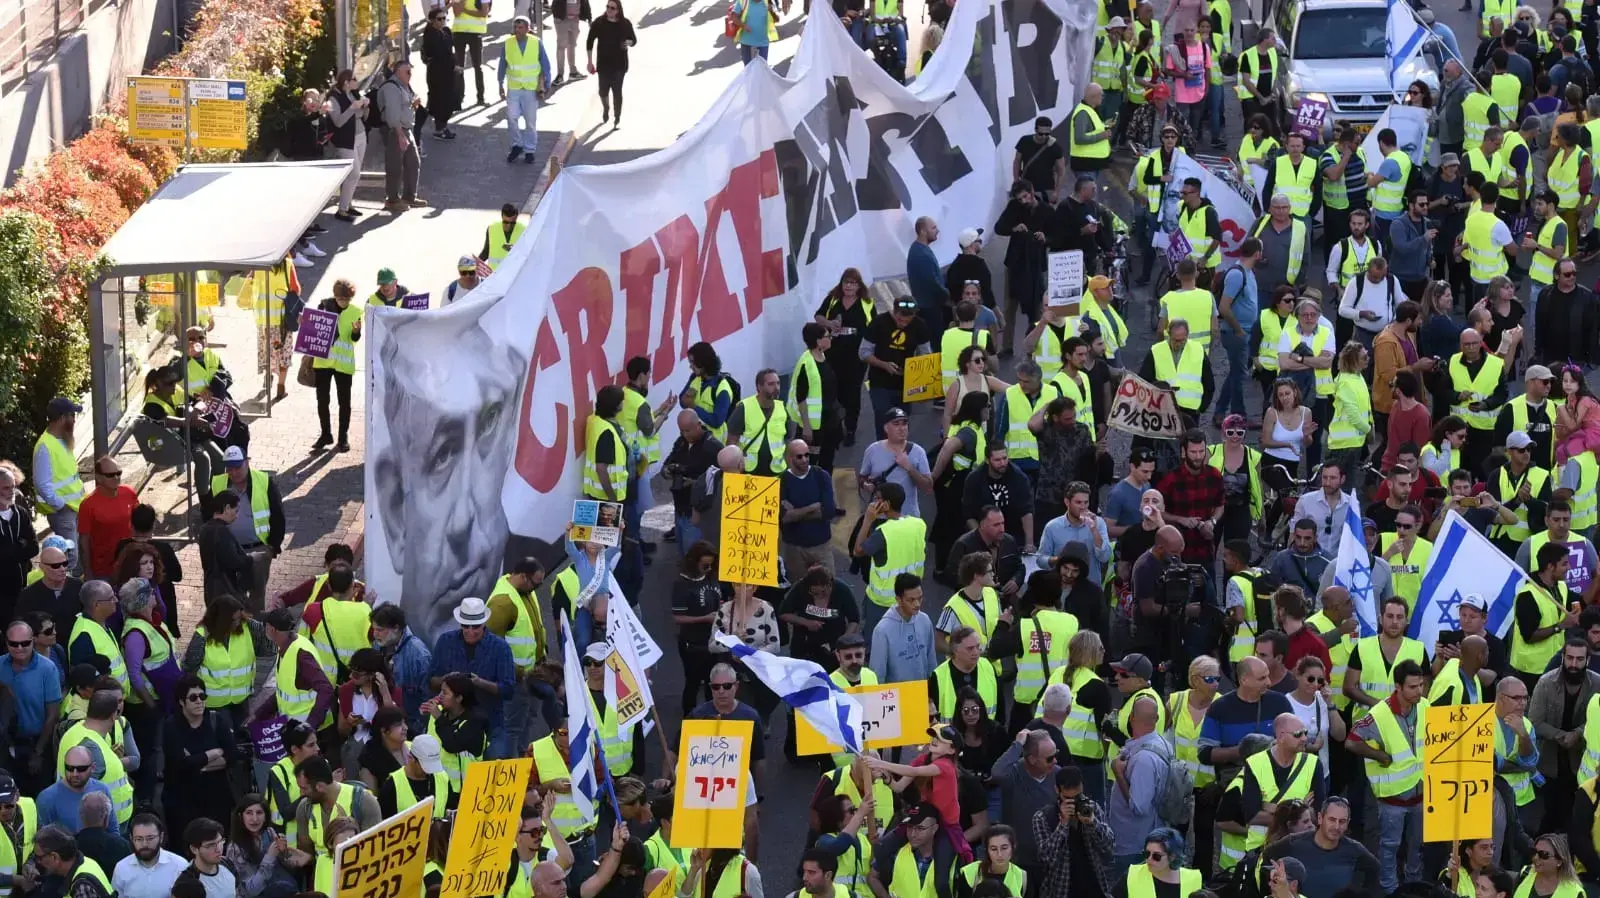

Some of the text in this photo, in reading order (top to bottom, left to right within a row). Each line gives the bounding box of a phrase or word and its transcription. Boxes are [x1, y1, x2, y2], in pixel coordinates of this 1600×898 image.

[1300, 103, 1325, 119] לא
[309, 313, 334, 325] שלטון
[514, 149, 786, 494] CRIME
[314, 322, 332, 333] העם
[304, 335, 329, 346] שלטון
[309, 344, 327, 353] ההון
[744, 478, 758, 491] לא
[764, 496, 779, 508] לא
[728, 526, 767, 547] ממשלה
[1568, 545, 1584, 567] ל
[881, 689, 894, 700] לא
[882, 705, 896, 719] ימין
[1450, 706, 1469, 723] לא
[861, 721, 879, 740] יק
[1477, 723, 1493, 737] לא
[709, 736, 729, 750] לא
[483, 764, 518, 795] מזון
[695, 776, 736, 802] יקר
[472, 786, 517, 815] מרפא
[341, 815, 425, 869] אפודים
[341, 841, 421, 891] צהובים
